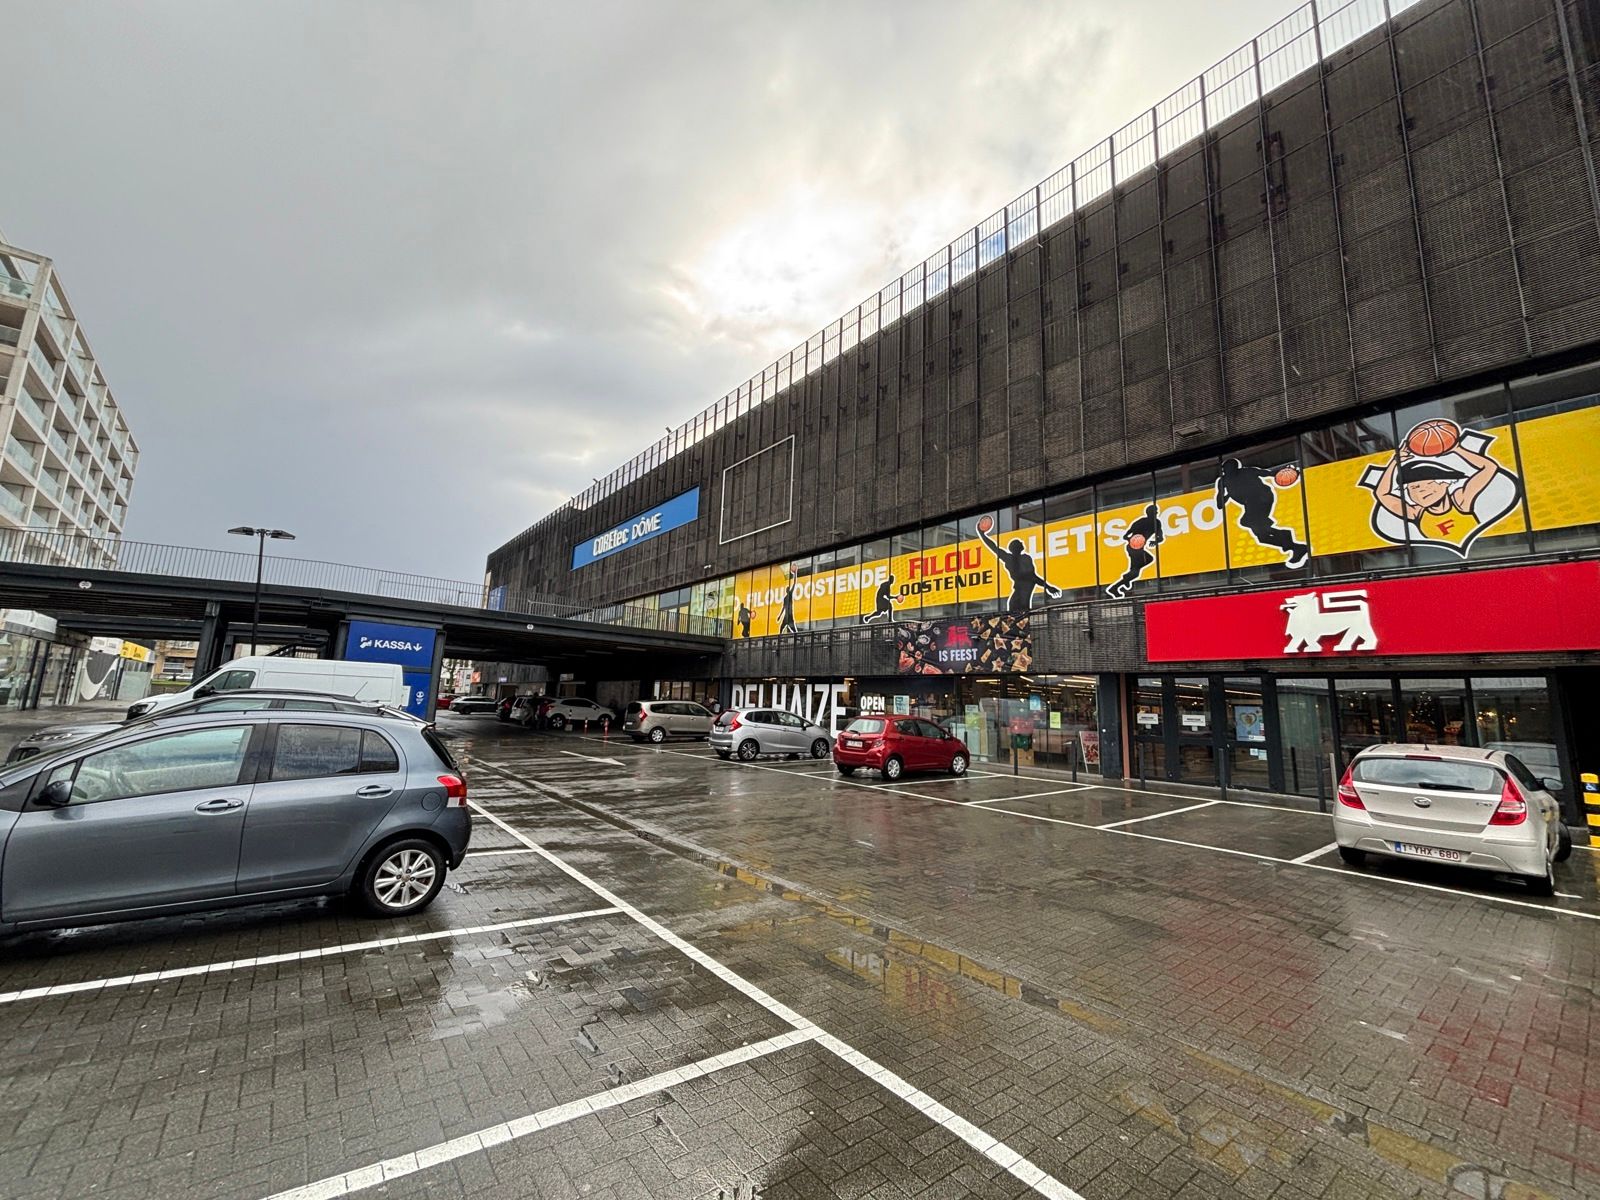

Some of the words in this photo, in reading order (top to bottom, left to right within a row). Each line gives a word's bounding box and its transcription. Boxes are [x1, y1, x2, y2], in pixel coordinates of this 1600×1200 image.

[632, 512, 663, 540] DÔME
[1029, 518, 1126, 560] LET'S
[1159, 499, 1223, 538] GO
[1436, 519, 1454, 536] F
[908, 546, 981, 580] FILOU
[746, 587, 785, 609] FILOU
[793, 565, 887, 601] OOSTENDE
[900, 570, 992, 596] OOSTENDE
[374, 639, 412, 651] KASSA
[938, 650, 948, 662] IS
[950, 648, 978, 662] FEEST
[861, 695, 885, 711] OPEN
